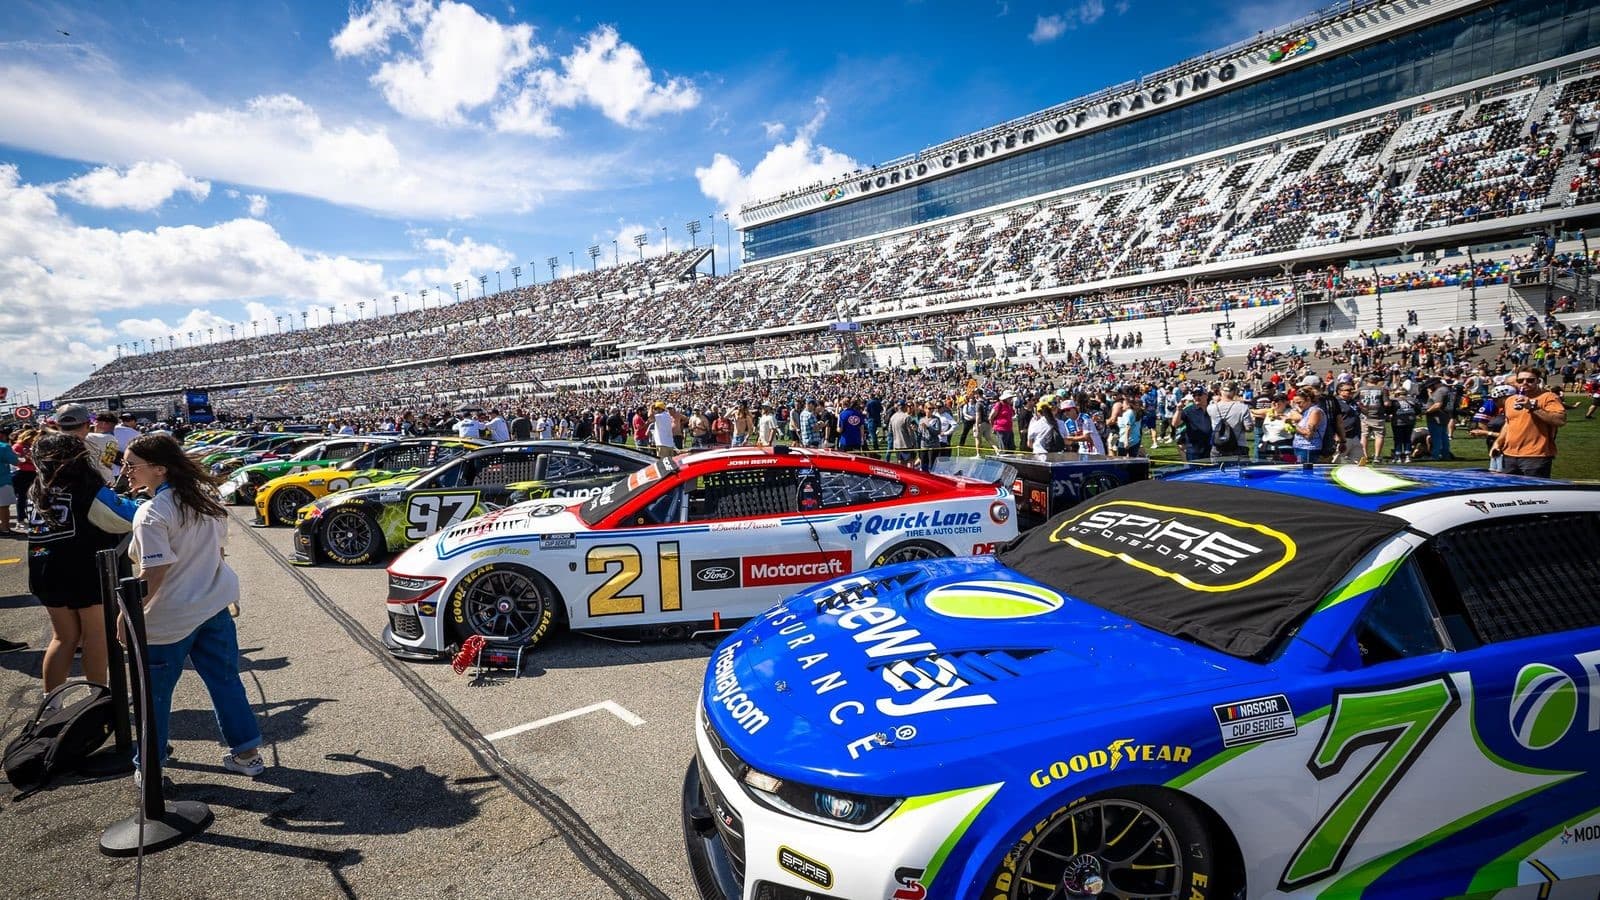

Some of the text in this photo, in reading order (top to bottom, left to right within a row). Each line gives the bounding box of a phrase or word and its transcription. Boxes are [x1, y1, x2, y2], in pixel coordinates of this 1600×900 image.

[860, 64, 1237, 192] WORLD CENTER OF RACING
[553, 486, 606, 500] Supe
[408, 494, 478, 540] 97
[864, 511, 981, 535] Quick Lane
[905, 526, 982, 537] TIRE & AUTO CENTER
[1069, 526, 1226, 575] MOORSPORTS
[1079, 511, 1263, 566] SPIRE
[585, 541, 683, 617] 21
[703, 558, 842, 580] Ford Motorcraft
[531, 609, 552, 644] EAGLE
[711, 640, 771, 735] Freeway.com
[763, 604, 881, 759] NSURANCE
[1232, 717, 1285, 737] CUP SERIES
[1240, 699, 1278, 717] NASCAR
[1277, 672, 1461, 893] 7
[782, 851, 828, 880] SPIRE
